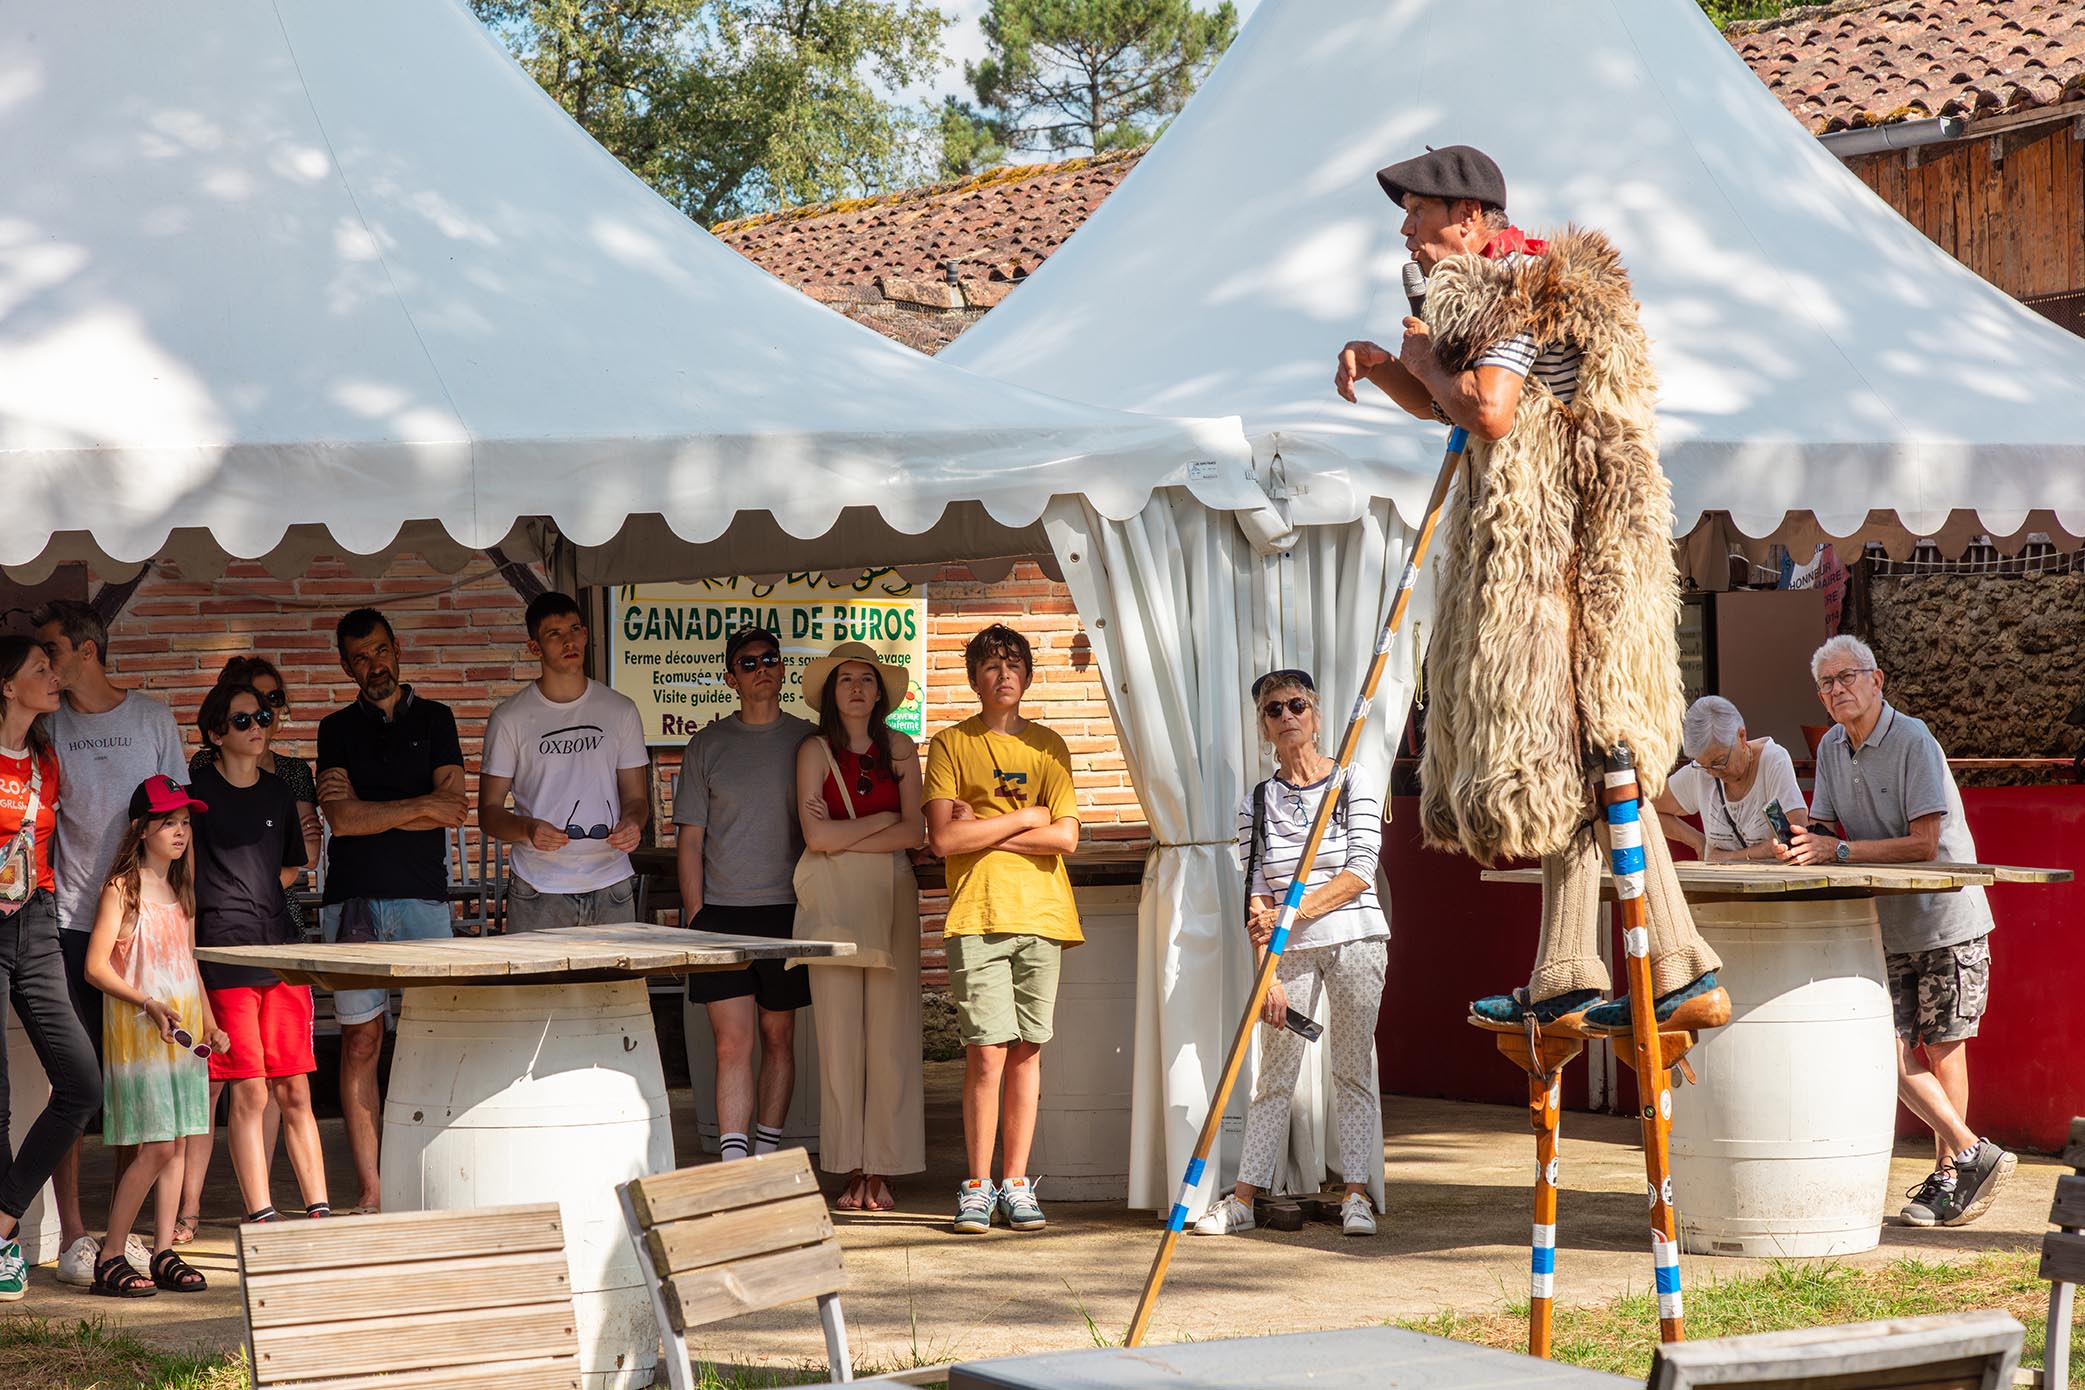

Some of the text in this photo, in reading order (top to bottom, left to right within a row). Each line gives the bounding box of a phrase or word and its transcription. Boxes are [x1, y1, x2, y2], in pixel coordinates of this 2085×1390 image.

[793, 606, 823, 640] DE
[834, 606, 916, 641] BUROS
[624, 651, 661, 665] Ferme
[665, 650, 725, 664] découvert
[653, 669, 711, 686] Ecomusée
[653, 689, 732, 707] Visite guidée
[662, 714, 697, 735] Rte
[68, 737, 132, 751] HONOLULU
[539, 735, 605, 755] OXBOW
